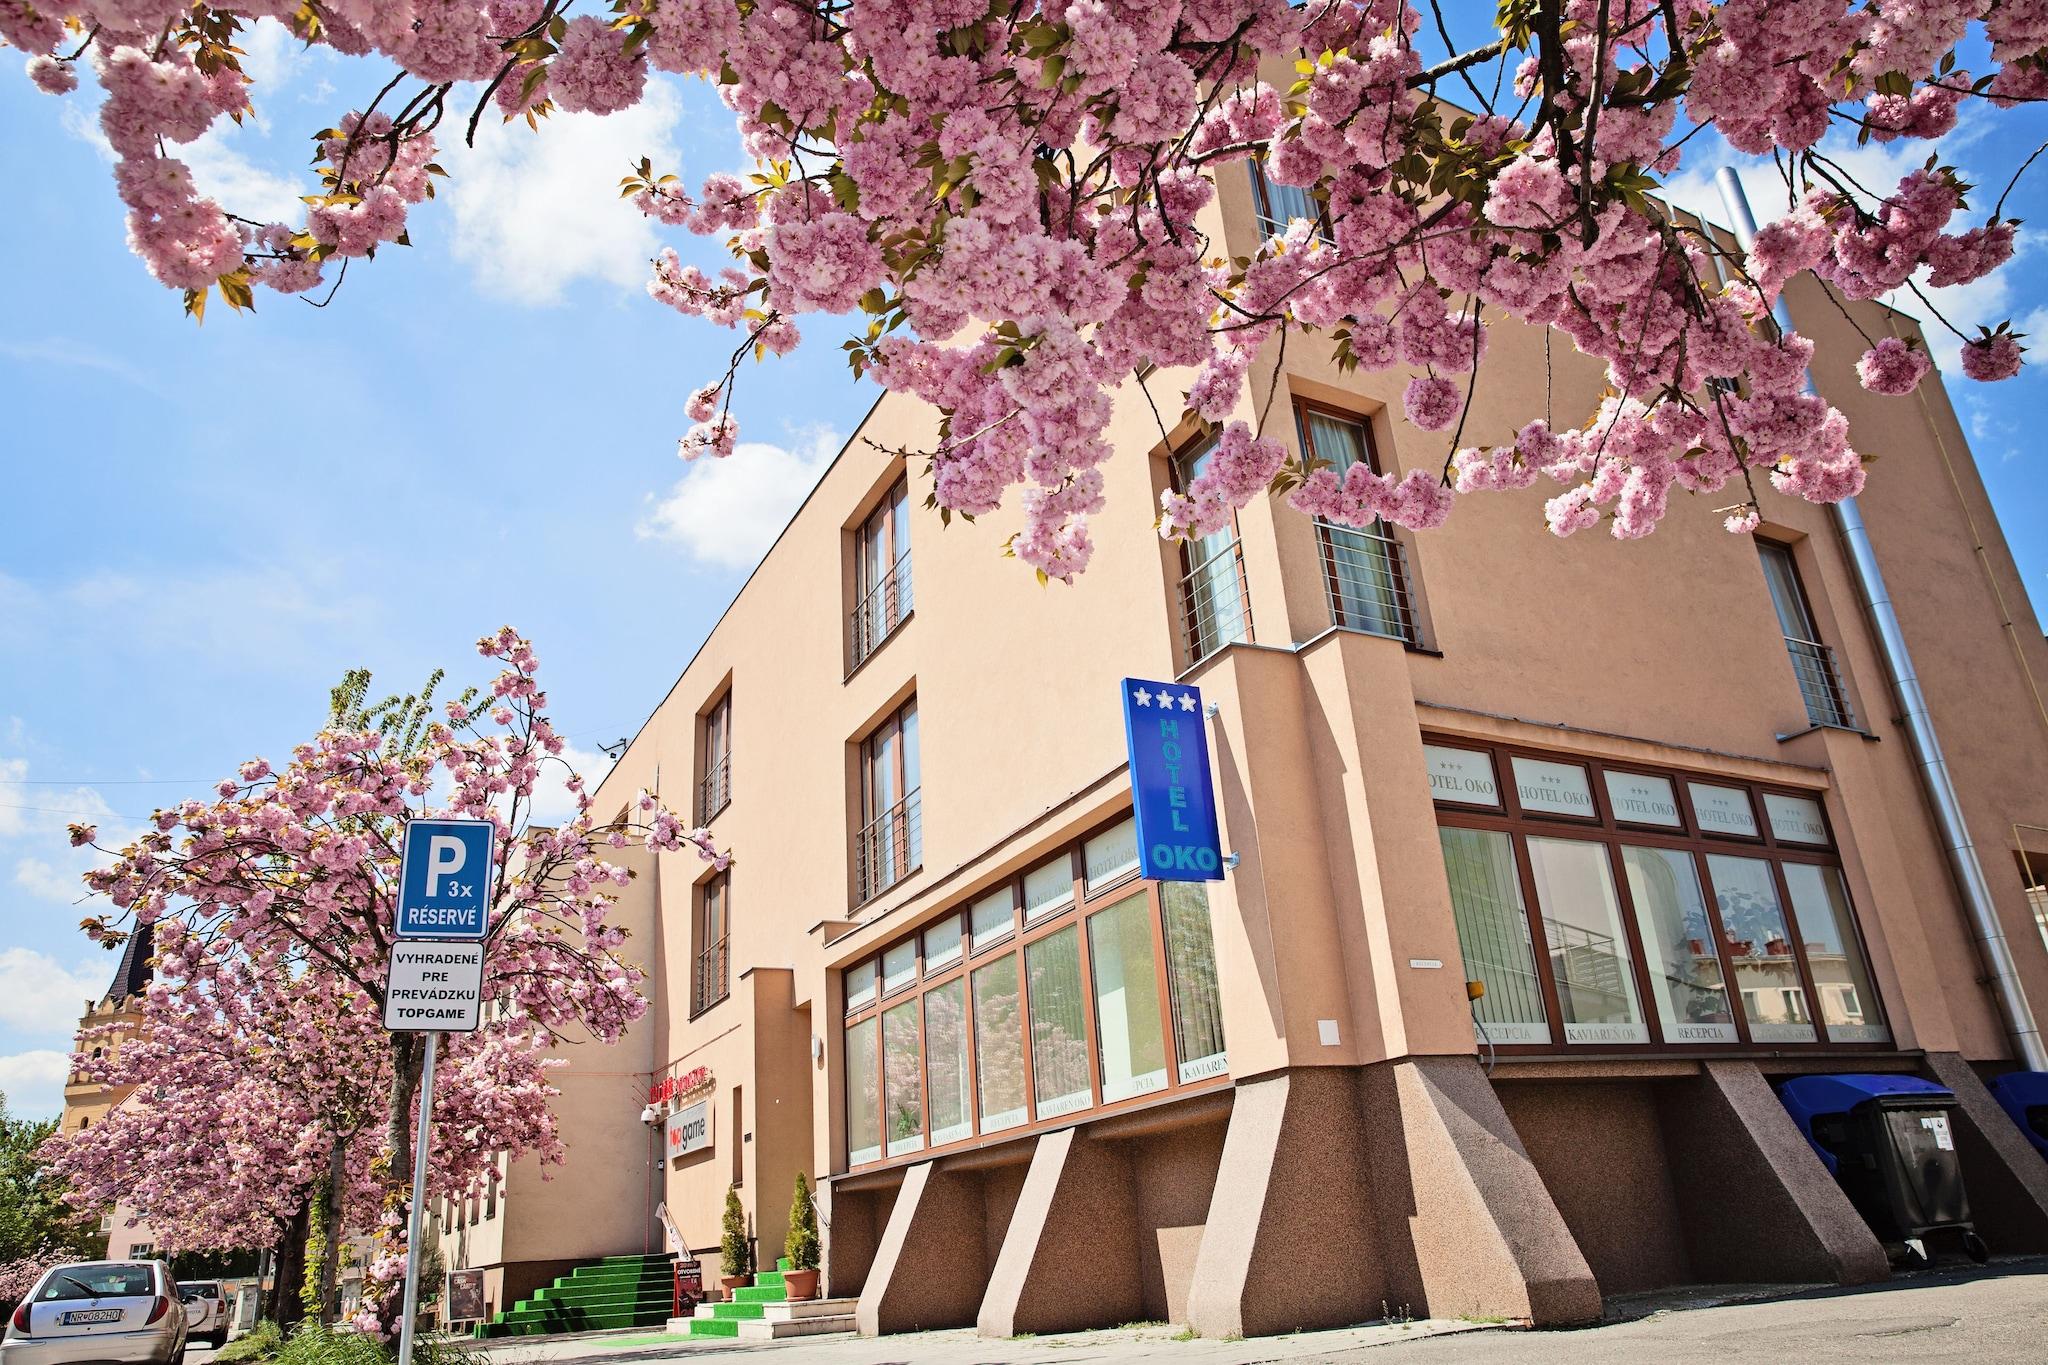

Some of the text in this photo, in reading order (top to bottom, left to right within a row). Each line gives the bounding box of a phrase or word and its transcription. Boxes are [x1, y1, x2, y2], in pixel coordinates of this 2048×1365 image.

[1159, 718, 1190, 833] HOTEL
[1427, 773, 1494, 794] OTEL OKO
[1518, 785, 1590, 805] HOTEL OKO
[1651, 801, 1676, 816] OKO
[1696, 808, 1753, 826] HOTEL OKO
[1803, 823, 1824, 836] OKO
[1151, 843, 1218, 872] OKO
[425, 835, 473, 898] P 3x
[408, 905, 477, 926] RÉSERVÉ
[396, 952, 479, 965] VYHRADENÉ
[422, 972, 449, 982] PRE
[391, 987, 476, 1000] PREVÁDZKU
[397, 1008, 466, 1019] TOPGAME
[1677, 1027, 1725, 1039] RECEPCIA
